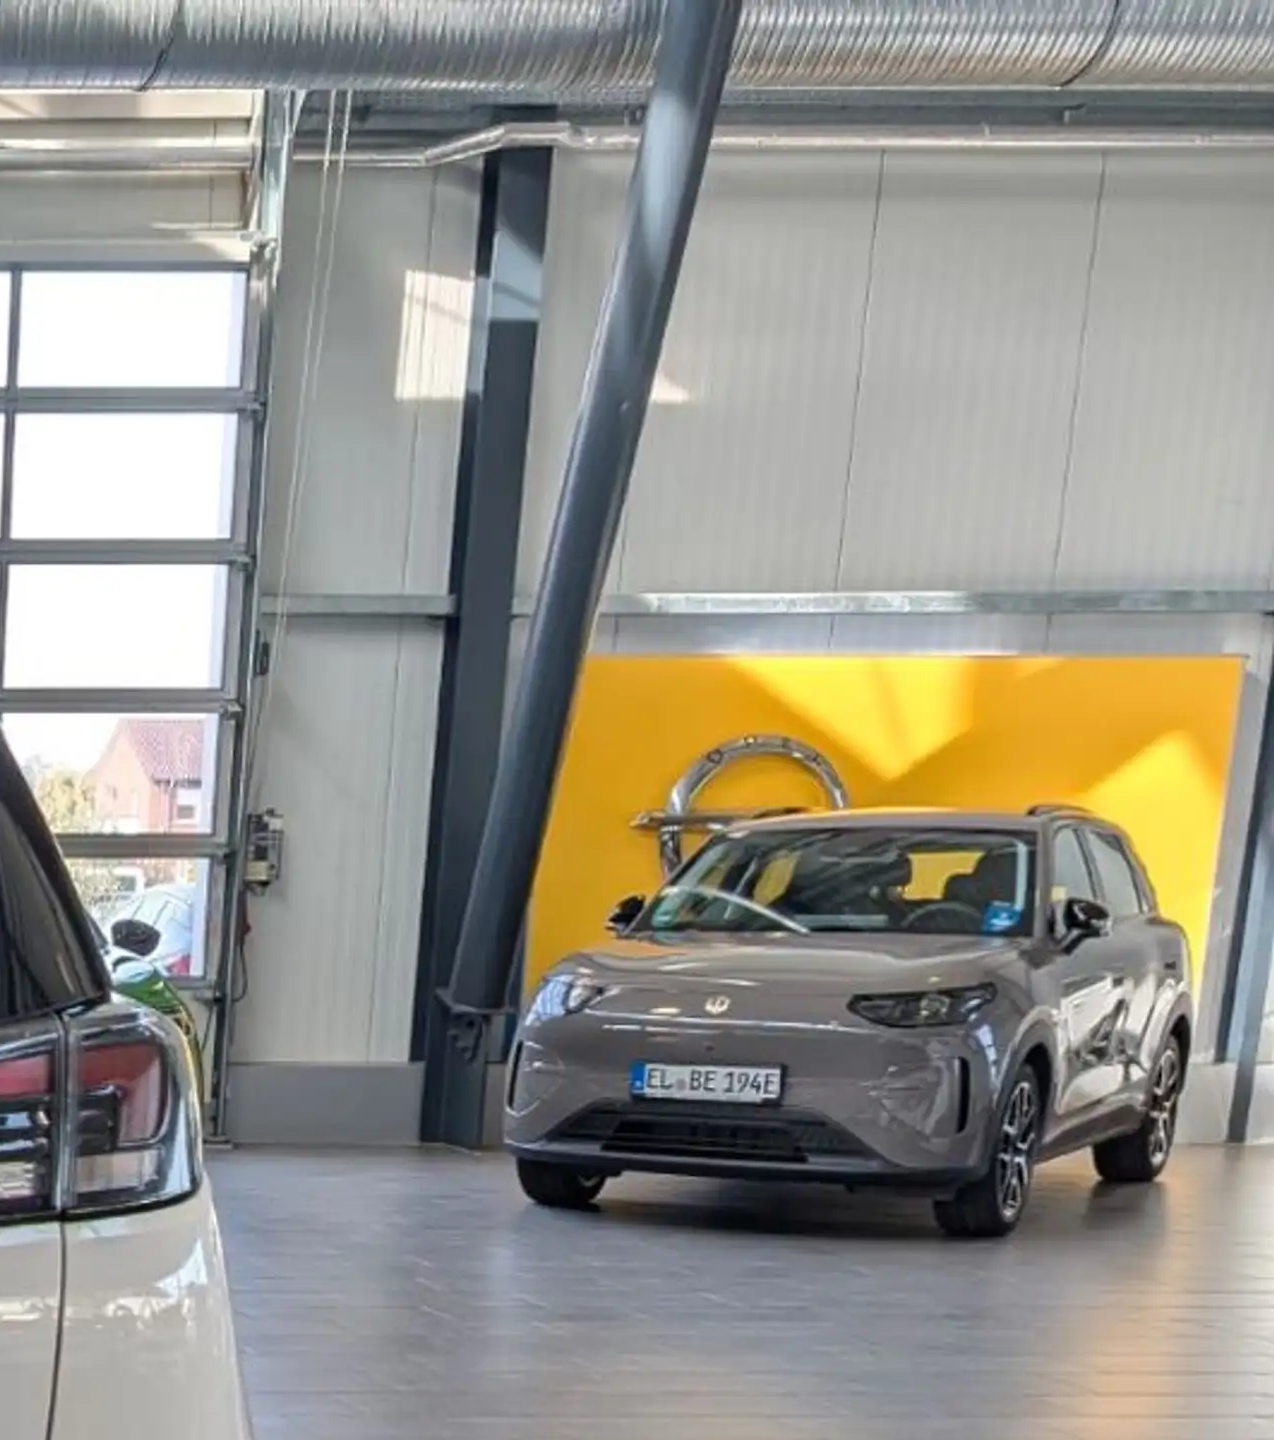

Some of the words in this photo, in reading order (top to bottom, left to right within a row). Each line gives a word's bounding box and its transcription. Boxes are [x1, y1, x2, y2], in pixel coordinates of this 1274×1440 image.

[647, 1068, 673, 1090] EL
[690, 1069, 718, 1092] BE
[723, 1072, 780, 1095] 194E
